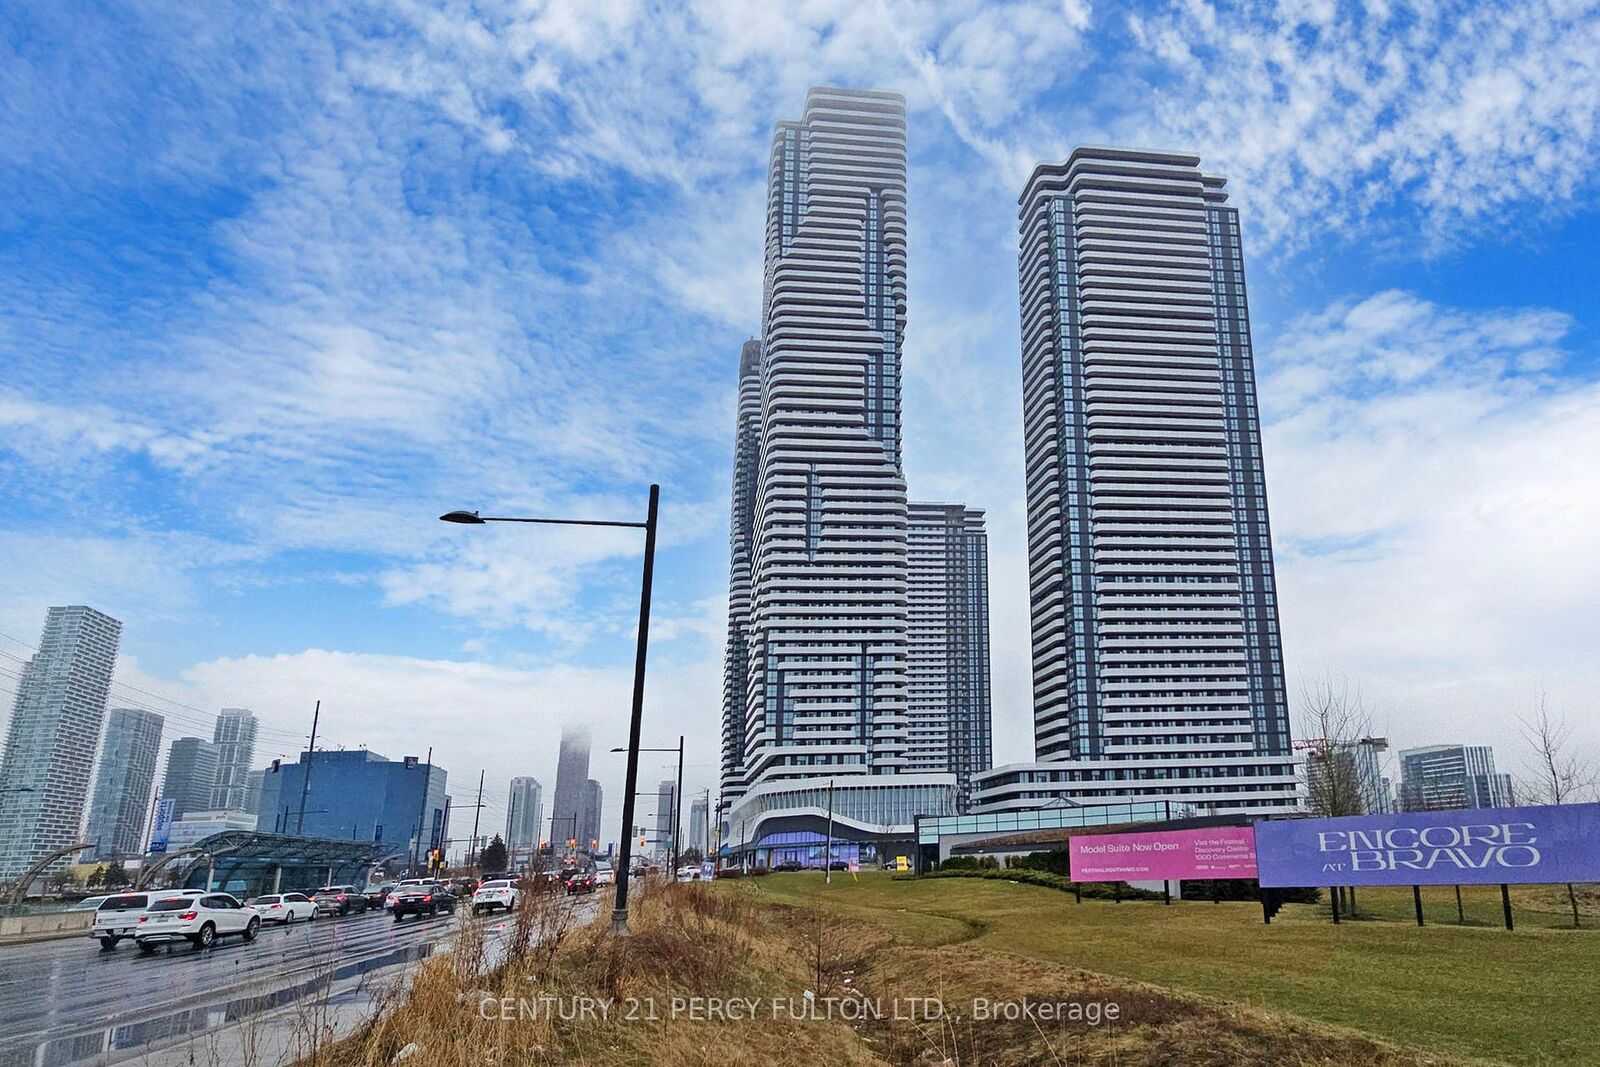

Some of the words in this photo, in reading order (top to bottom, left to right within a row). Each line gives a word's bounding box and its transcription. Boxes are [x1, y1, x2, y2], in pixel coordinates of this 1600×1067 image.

[1080, 846, 1105, 854] Model
[1107, 844, 1130, 853] Suite
[1132, 843, 1152, 852] Now
[1153, 841, 1179, 852] Open
[1318, 823, 1537, 851] ENCORE
[1322, 862, 1346, 872] AT
[1350, 845, 1541, 871] BRAVO
